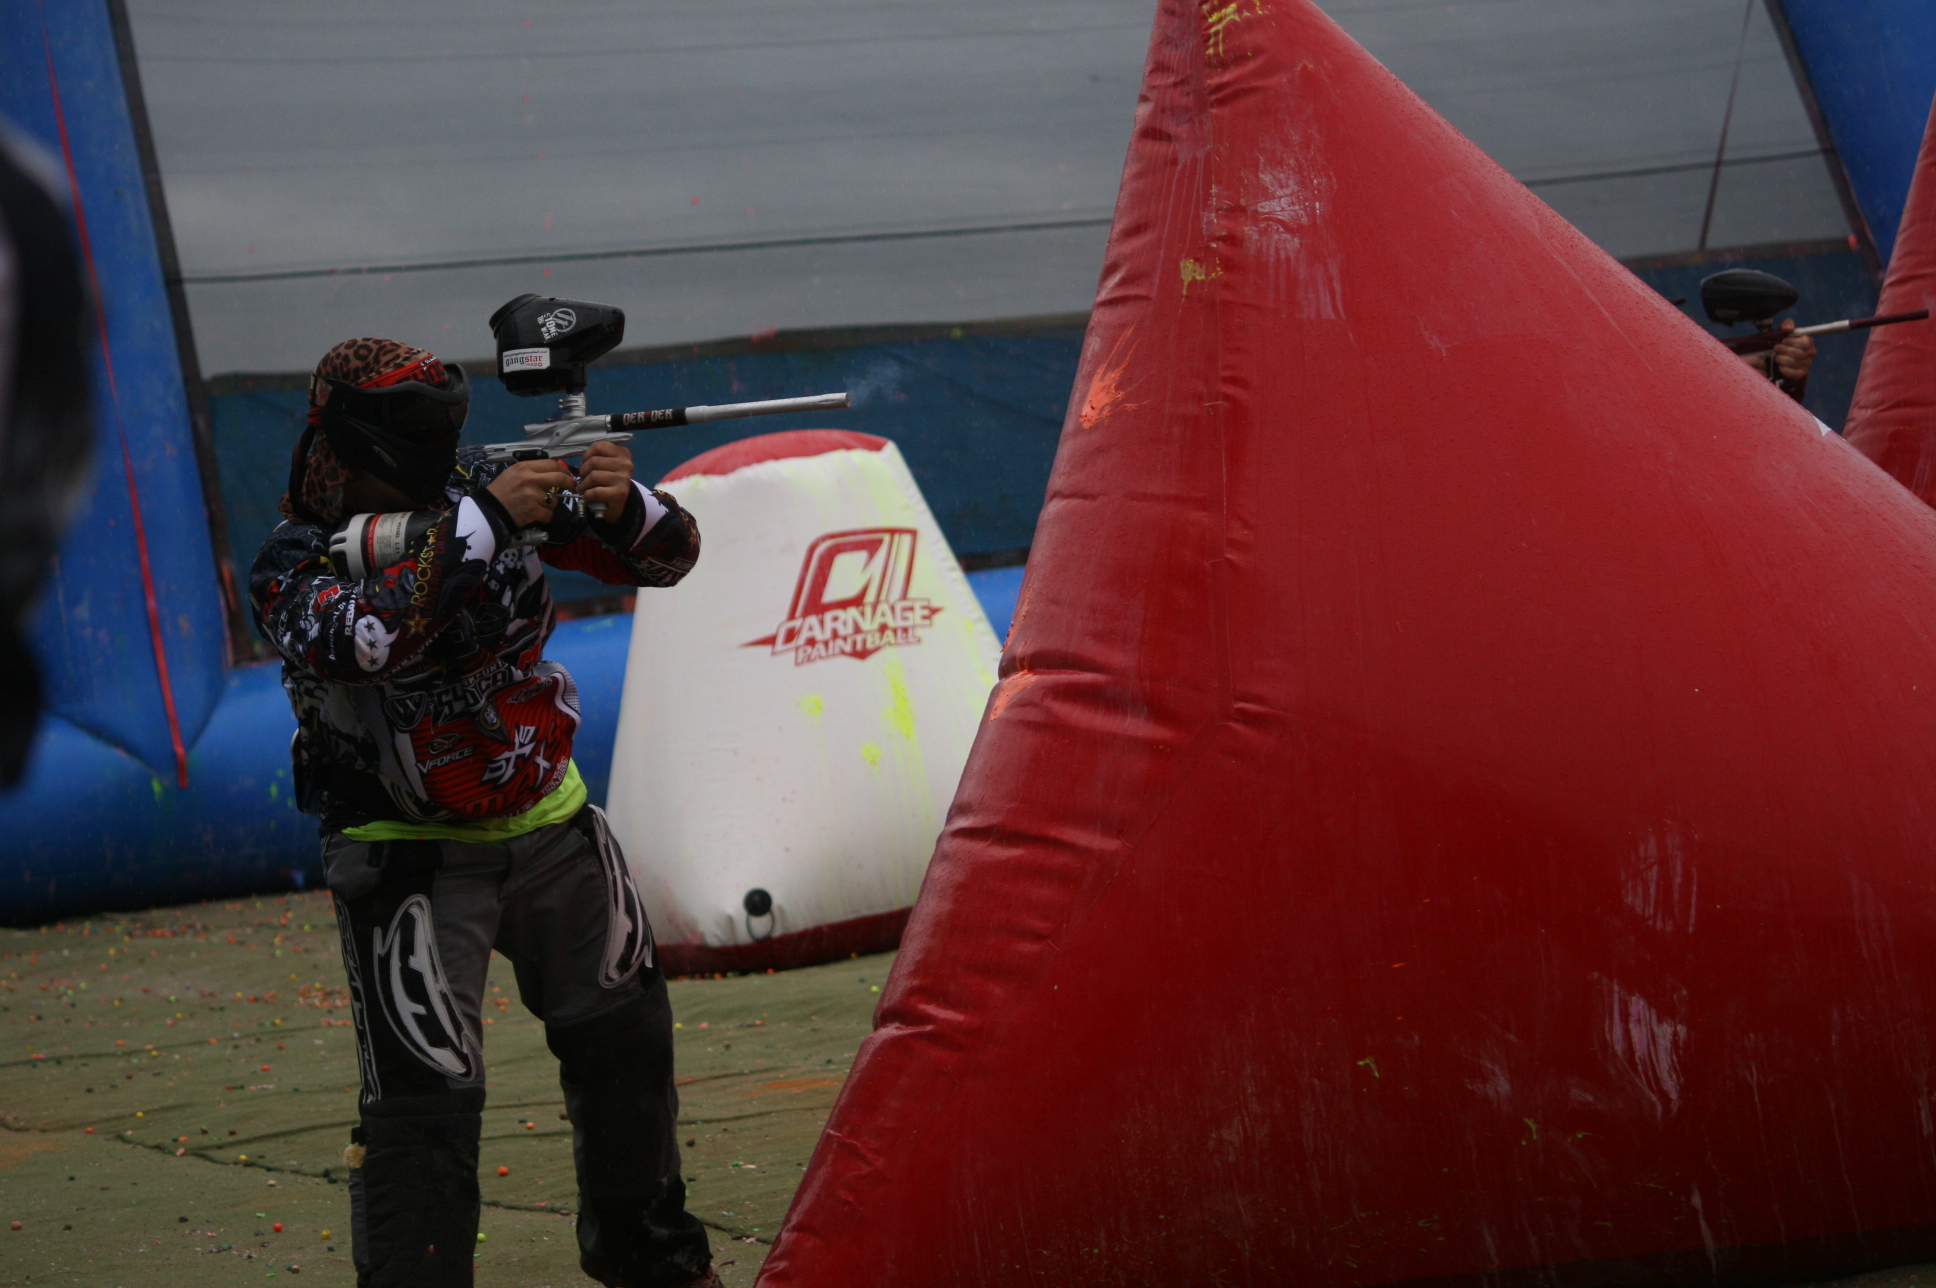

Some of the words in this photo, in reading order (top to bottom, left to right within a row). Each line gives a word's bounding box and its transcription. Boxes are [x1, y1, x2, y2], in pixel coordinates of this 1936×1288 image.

[505, 354, 543, 367] gangstar
[622, 411, 645, 426] DER
[650, 408, 673, 422] DER
[772, 598, 932, 656] CARNAGE
[794, 627, 921, 667] PAINTBALL
[415, 745, 475, 774] VFORCE
